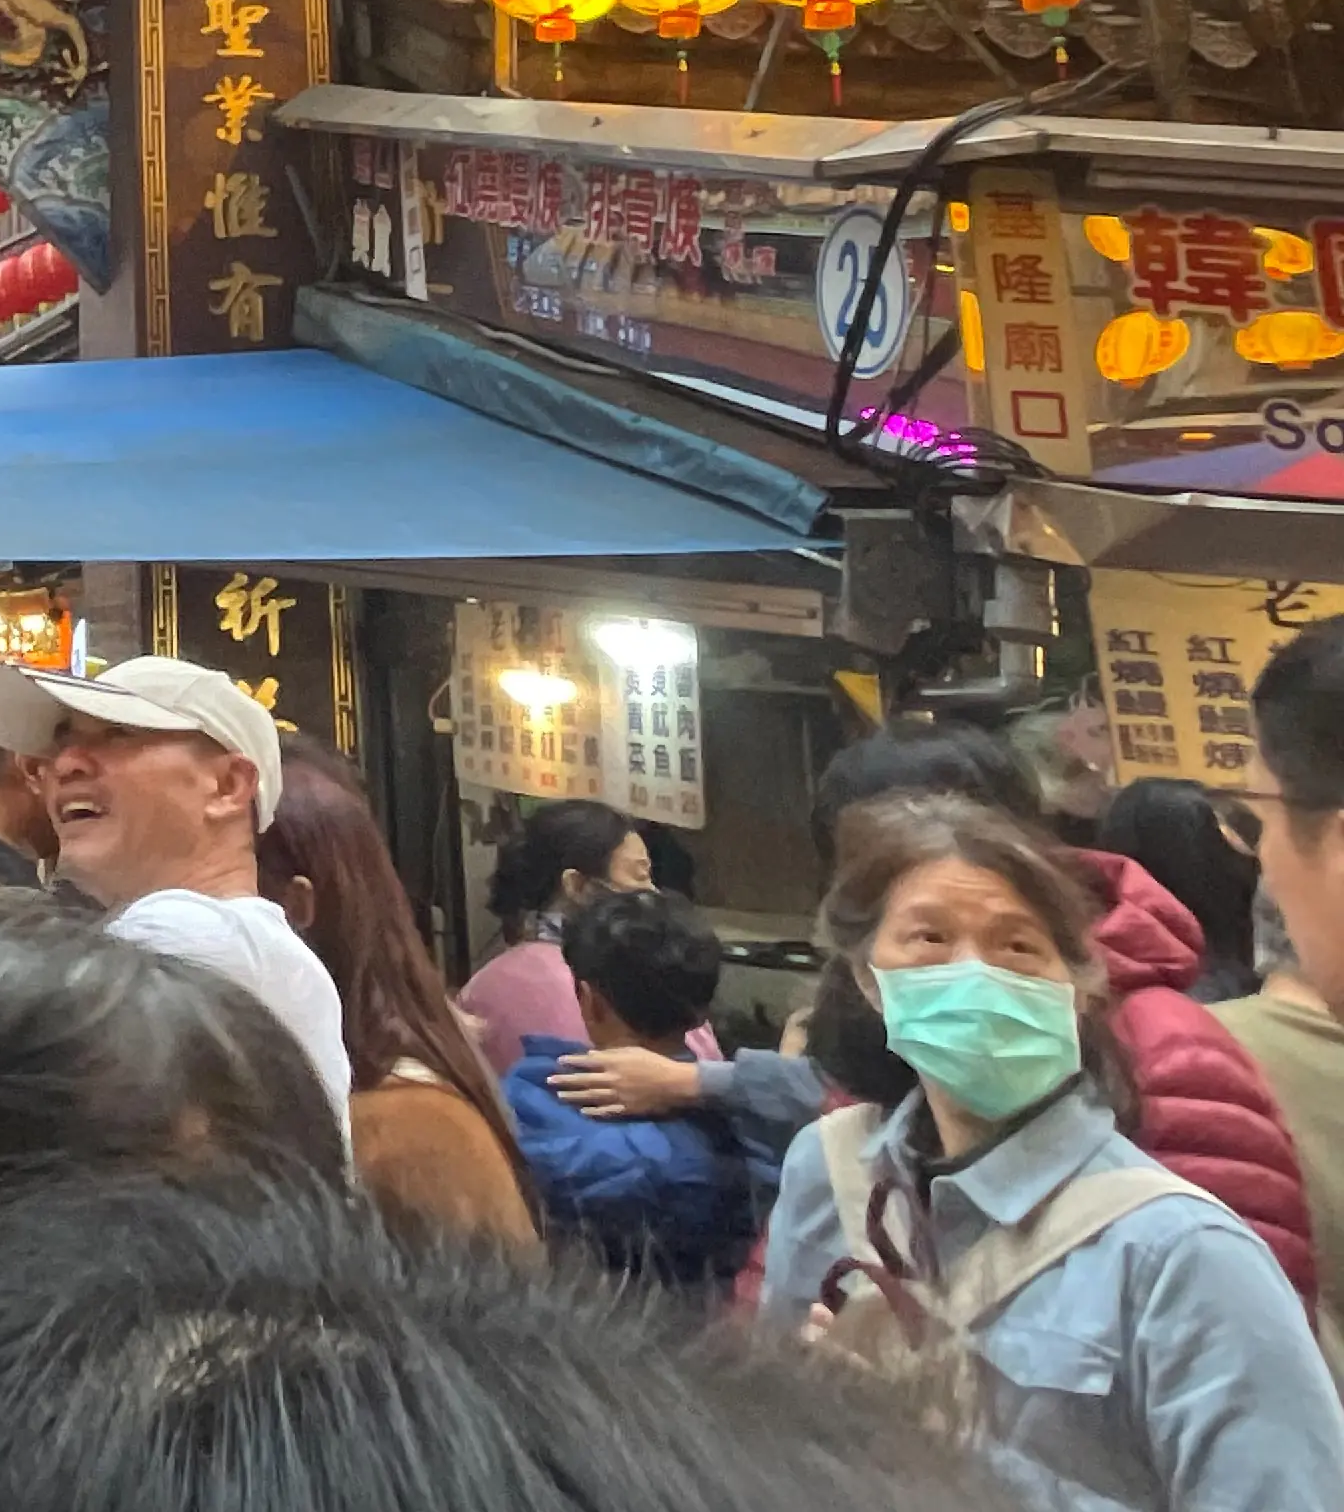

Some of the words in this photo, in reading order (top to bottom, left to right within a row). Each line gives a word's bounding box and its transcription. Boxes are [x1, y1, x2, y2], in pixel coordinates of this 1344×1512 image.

[836, 240, 889, 349] 25
[986, 190, 1070, 439] 基隆廟口
